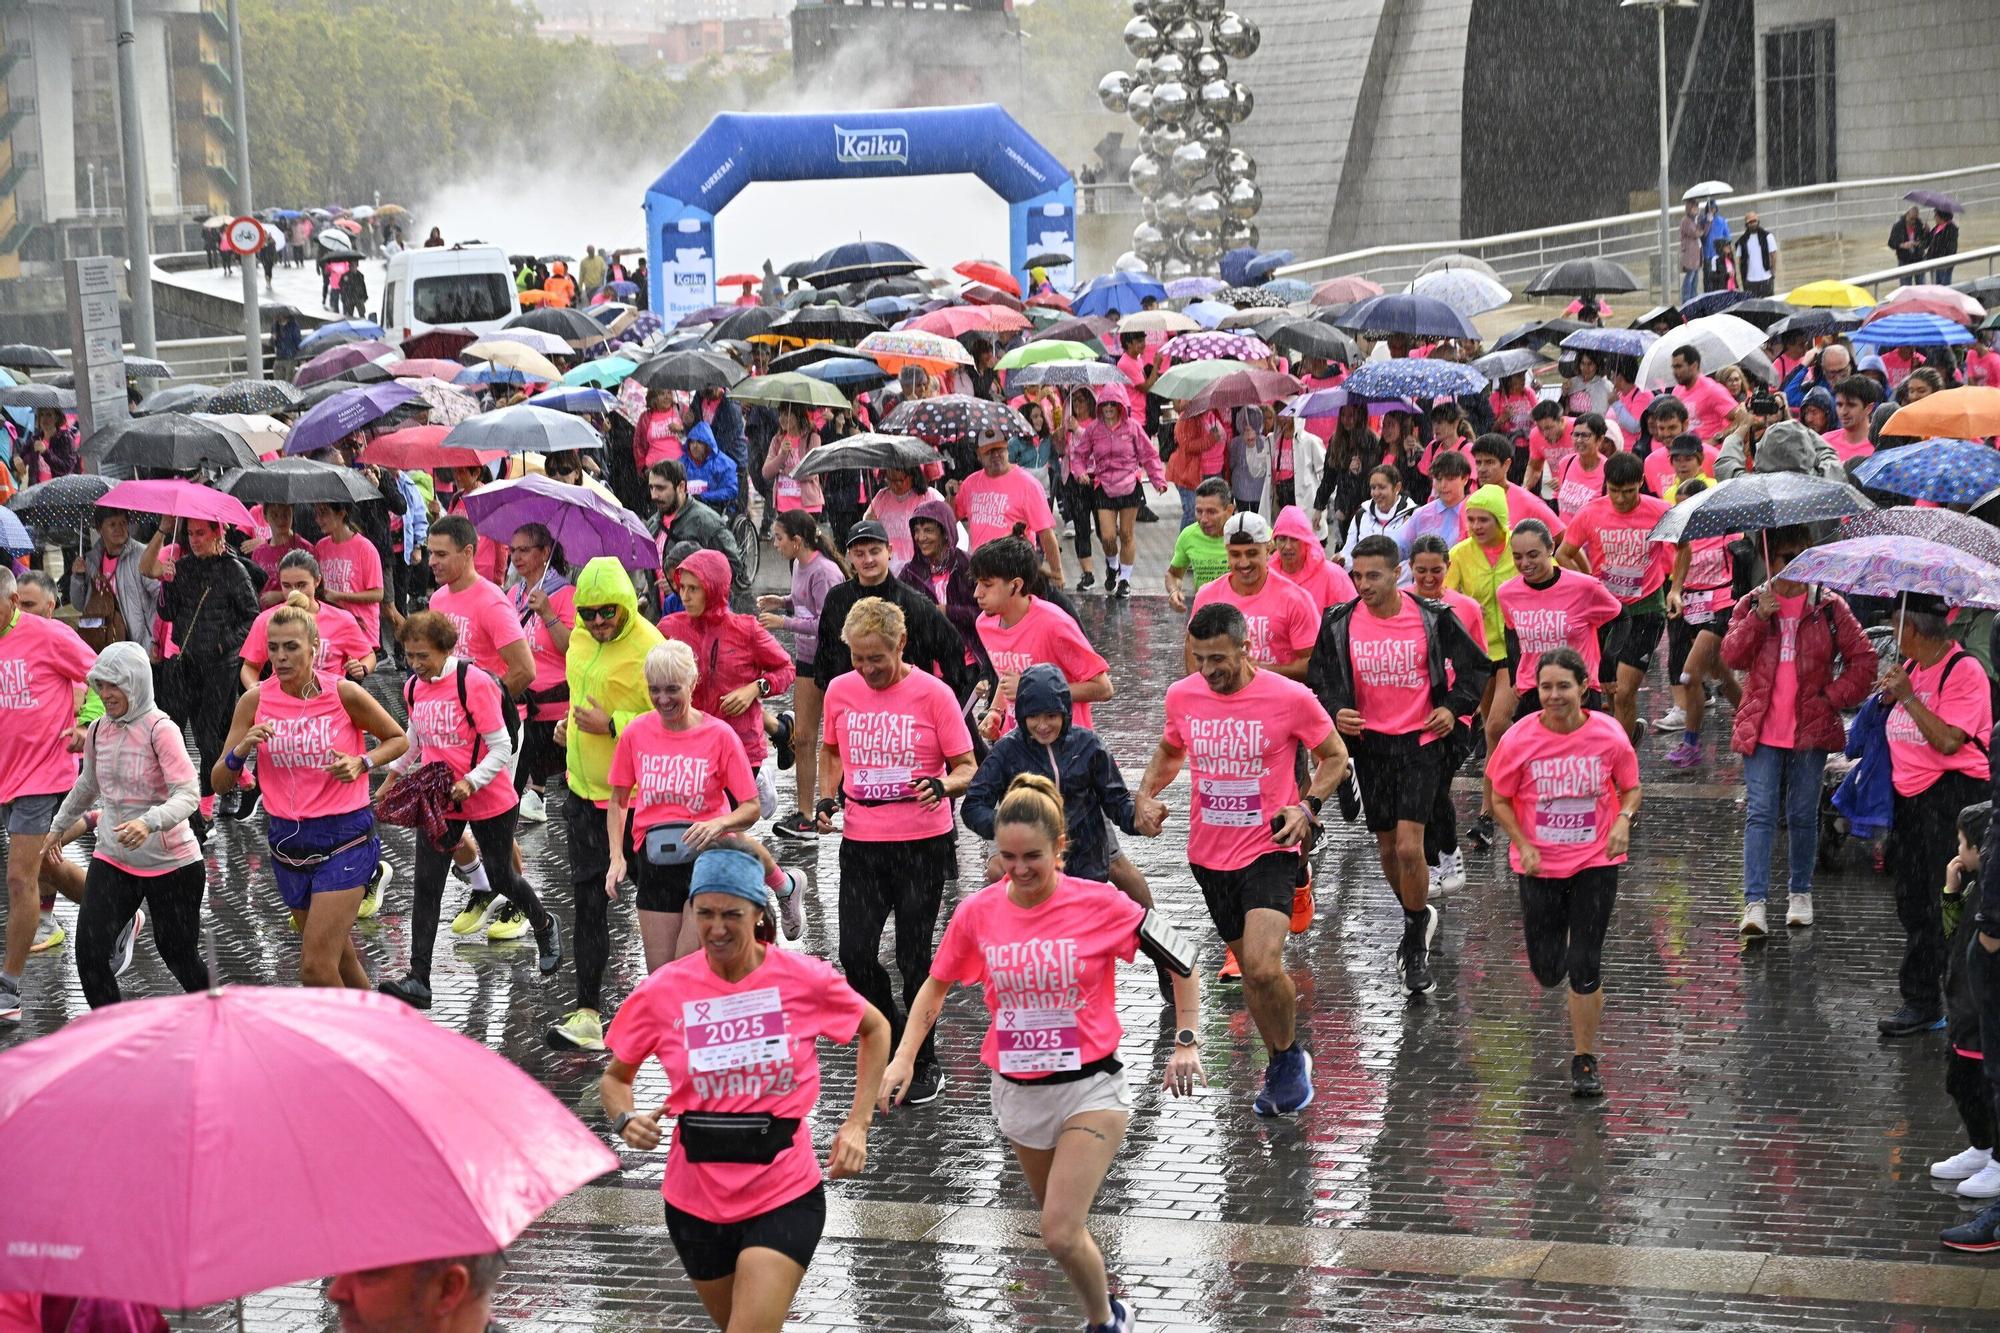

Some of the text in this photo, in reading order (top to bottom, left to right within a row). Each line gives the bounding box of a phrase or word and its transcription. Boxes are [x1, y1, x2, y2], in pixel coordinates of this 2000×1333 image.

[842, 132, 901, 160] Kaiku
[700, 157, 735, 194] AURRERA!
[676, 273, 706, 286] Kaiku
[864, 784, 900, 799] 2025
[1209, 796, 1248, 811] 2025
[1546, 813, 1585, 829] 2025
[705, 1015, 765, 1045] 2025
[1011, 1030, 1063, 1049] 2025
